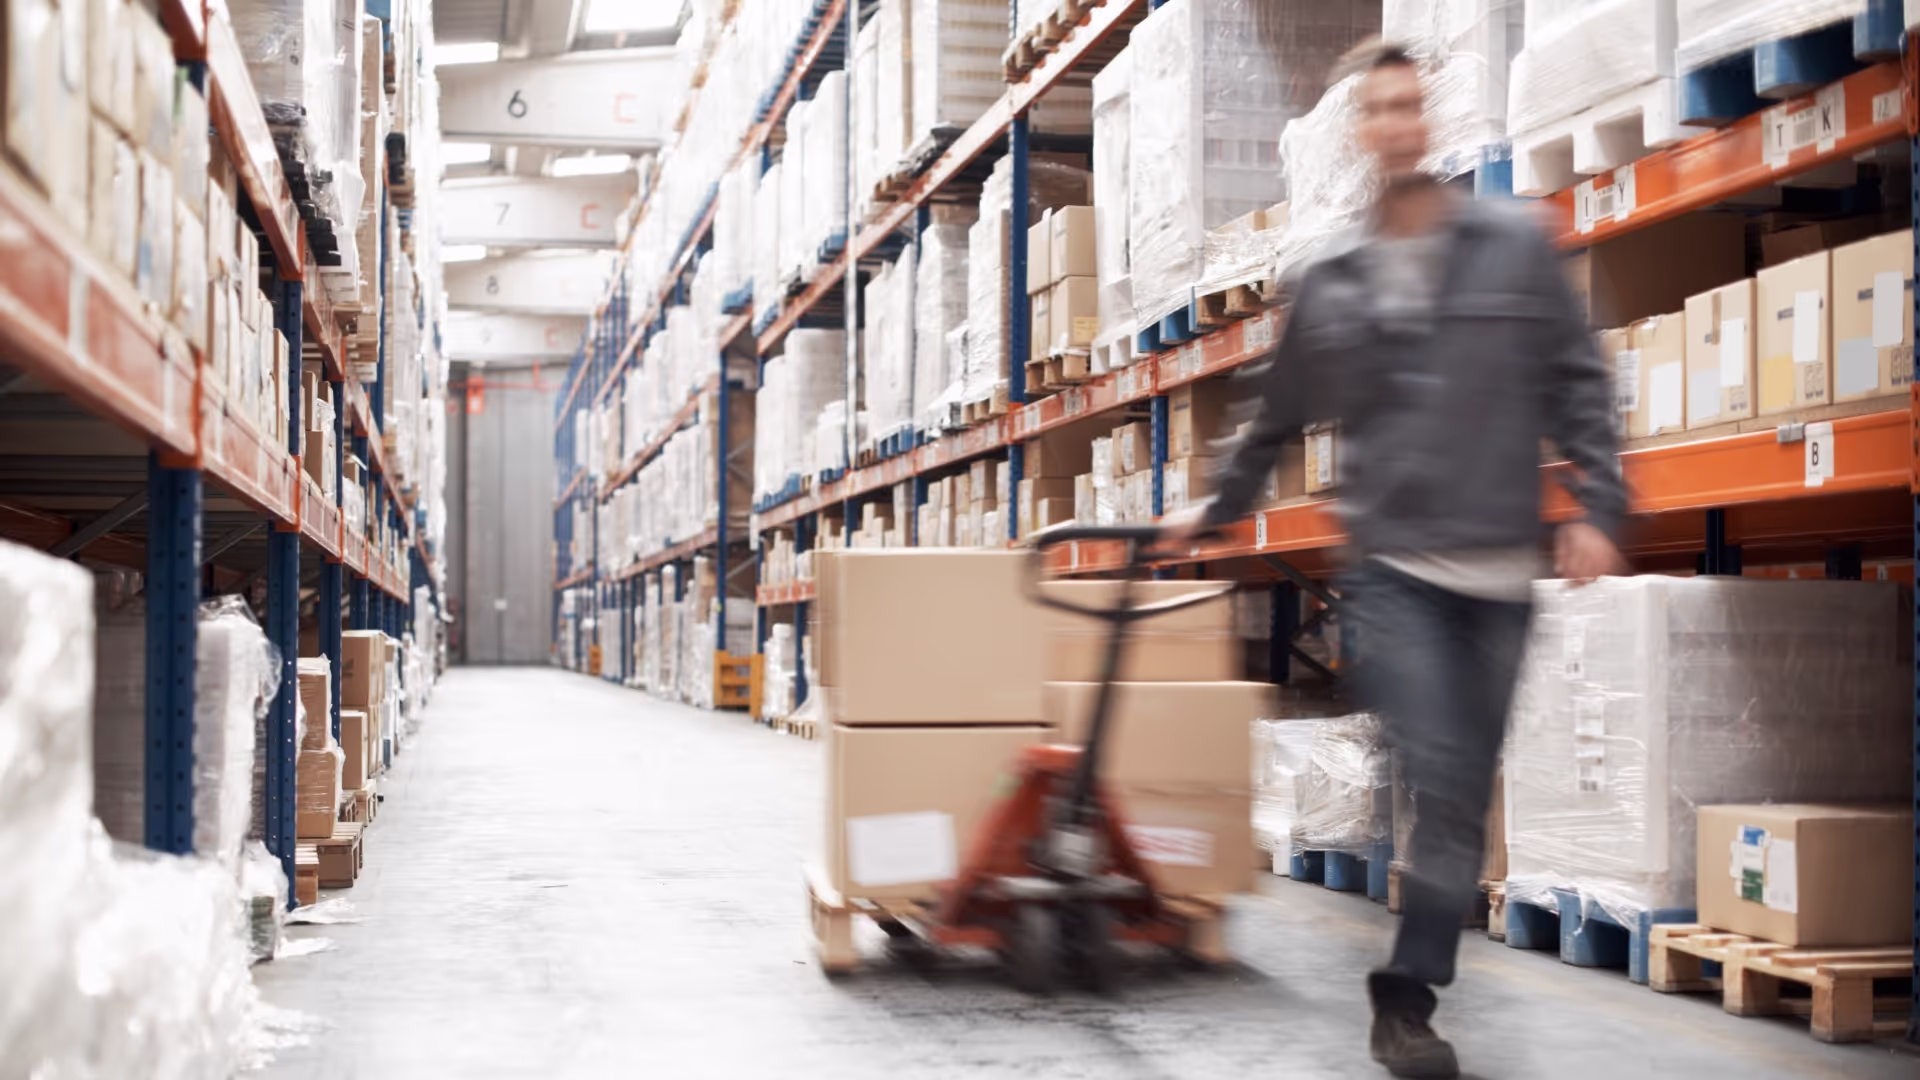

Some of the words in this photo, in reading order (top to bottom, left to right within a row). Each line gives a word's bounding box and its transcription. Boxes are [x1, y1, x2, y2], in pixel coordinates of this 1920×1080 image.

[507, 89, 528, 119] 6
[1822, 104, 1832, 132] K
[1776, 123, 1784, 148] T
[1618, 180, 1625, 204] Y
[495, 202, 512, 225] 7
[486, 275, 499, 295] 8
[1812, 441, 1819, 466] B
